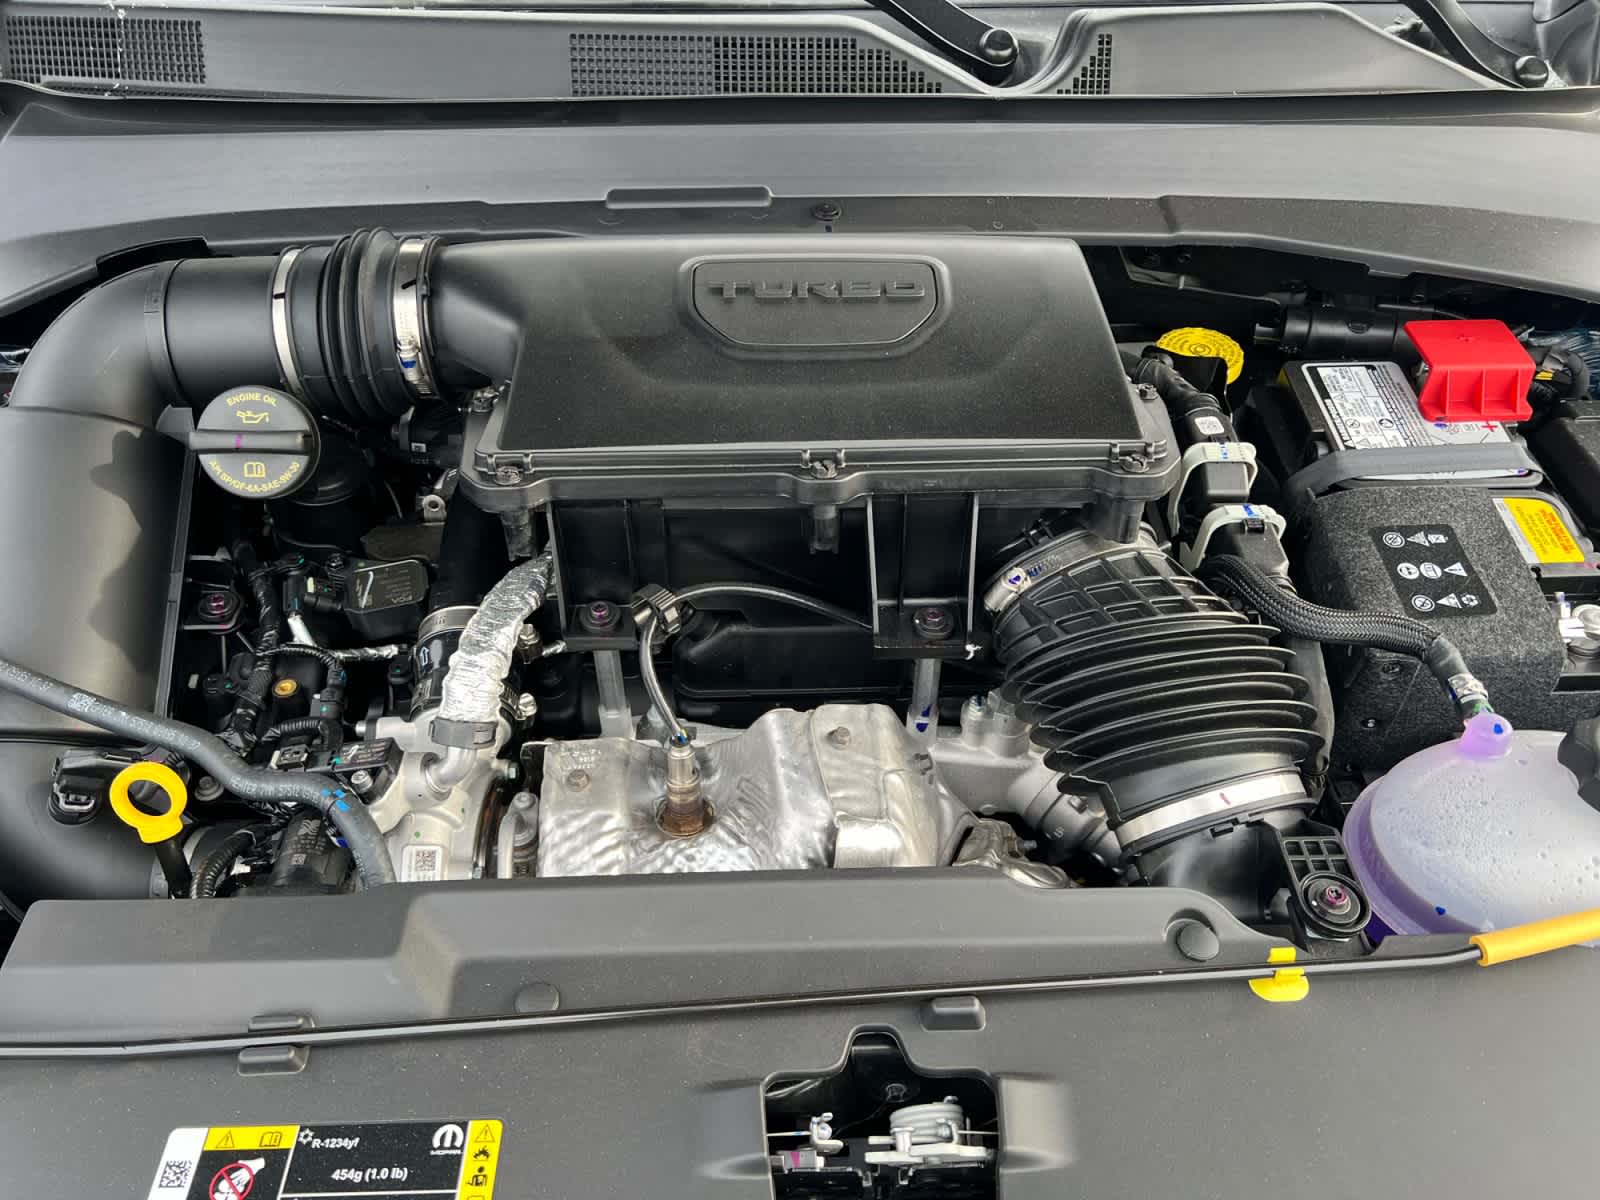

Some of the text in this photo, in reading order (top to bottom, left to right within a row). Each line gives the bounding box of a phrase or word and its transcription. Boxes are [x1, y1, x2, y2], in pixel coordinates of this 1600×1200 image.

[707, 279, 925, 300] TURBO
[226, 392, 277, 407] ENGINE OIL
[311, 1137, 360, 1150] R-1234yf
[331, 1167, 408, 1183] 454g (1.0 lb)
